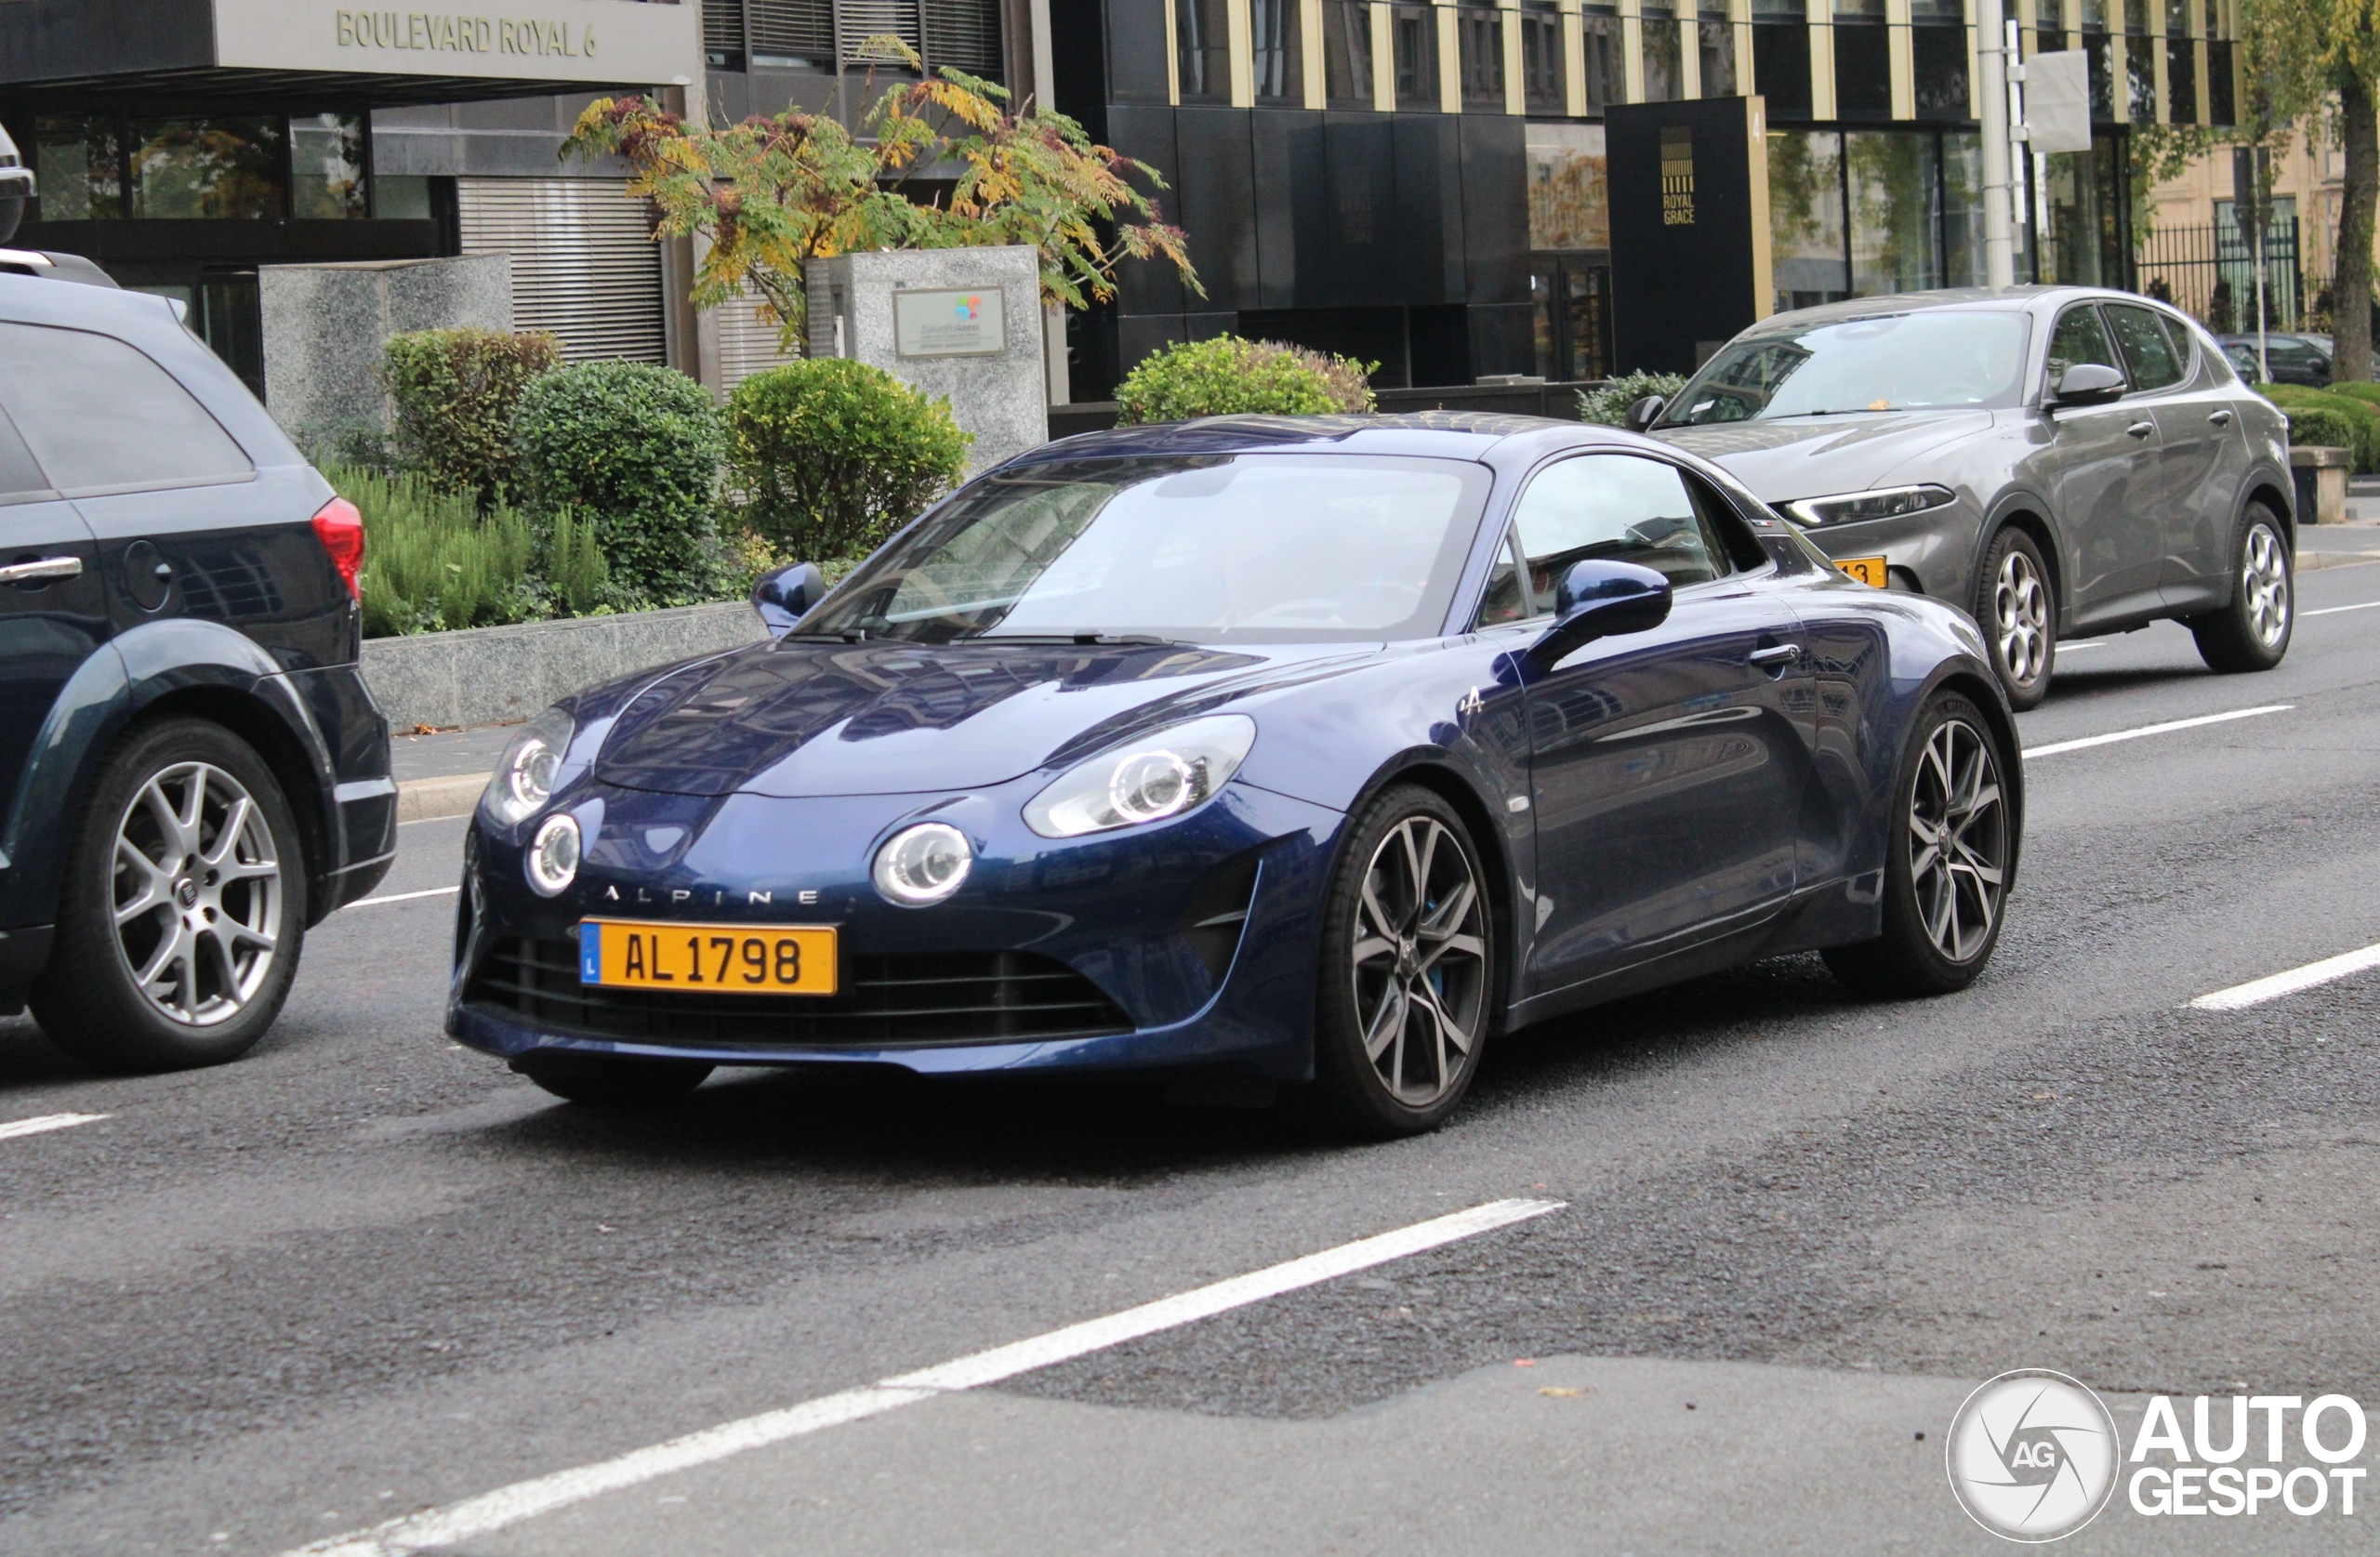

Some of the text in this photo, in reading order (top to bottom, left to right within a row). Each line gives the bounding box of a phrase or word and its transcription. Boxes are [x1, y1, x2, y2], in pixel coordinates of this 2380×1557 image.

[337, 9, 597, 58] BOULEVARD ROYAL 6
[1752, 112, 1760, 143] 4
[1662, 193, 1695, 210] ROYAL
[1663, 208, 1696, 226] GRACE
[605, 885, 818, 904] ALPINE
[586, 957, 596, 975] L
[625, 933, 801, 984] AL 1798
